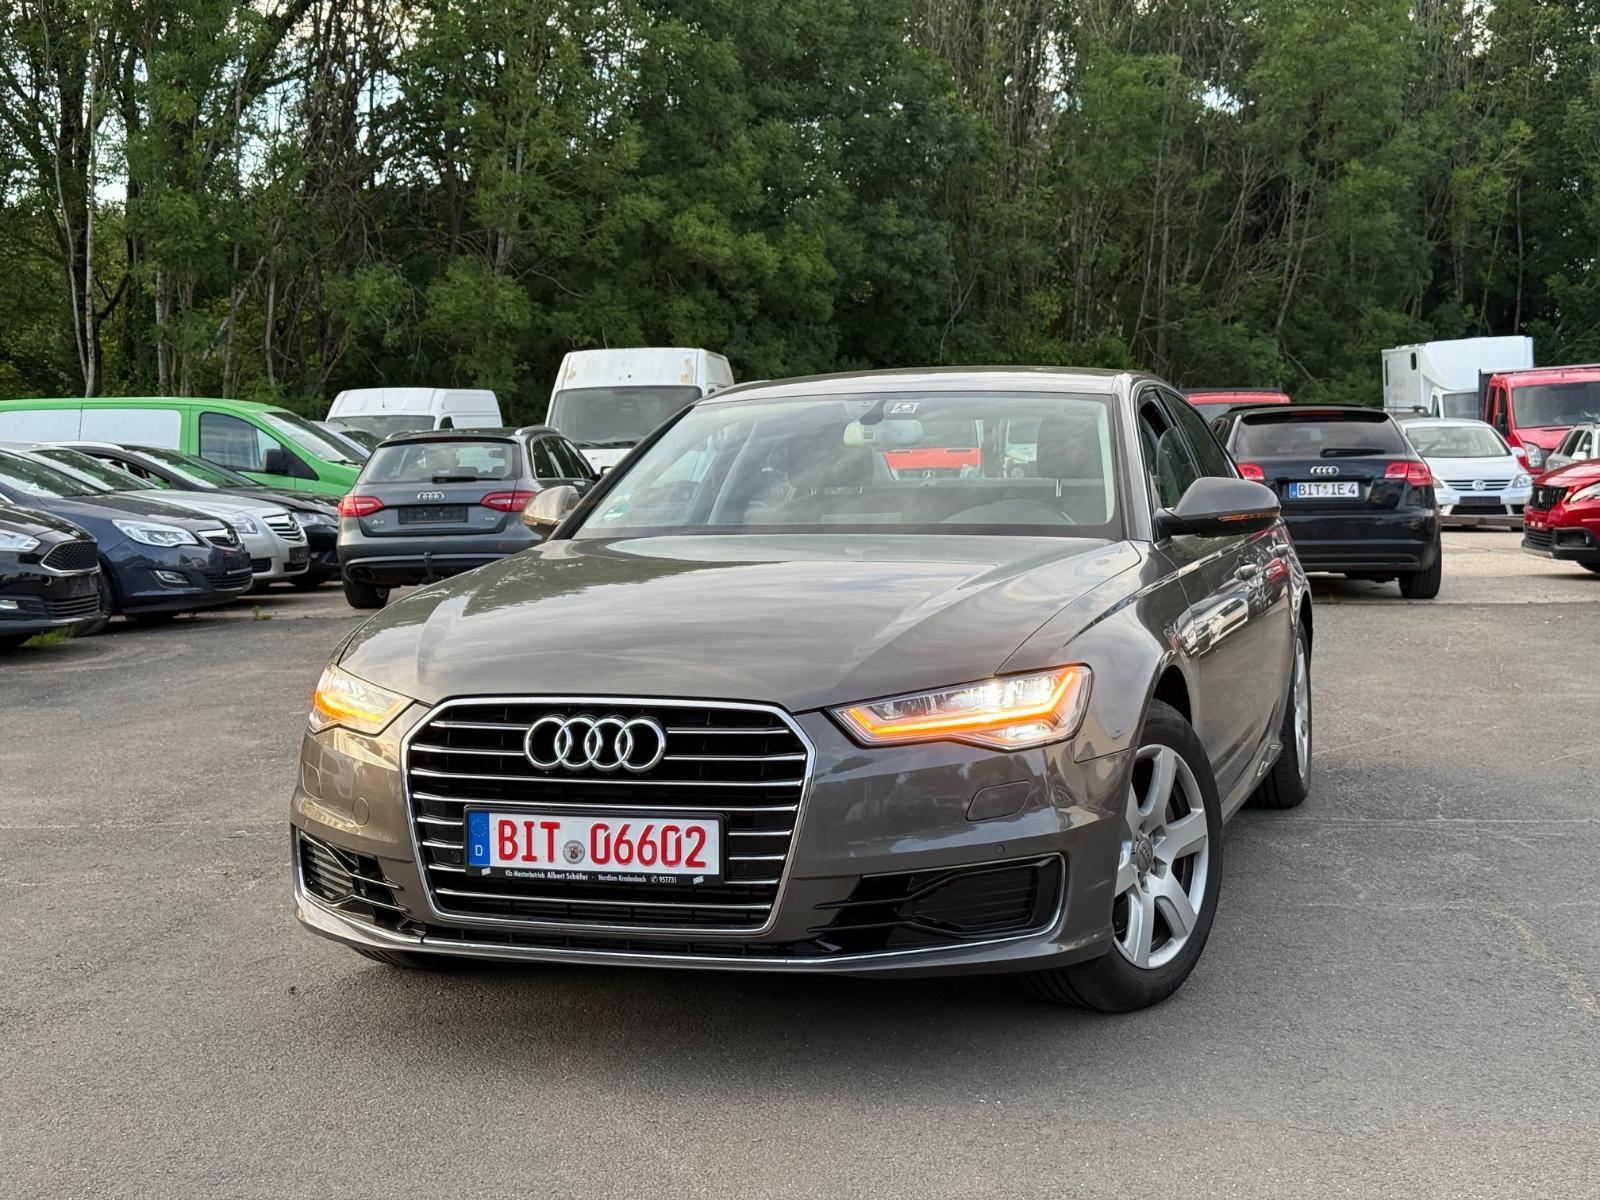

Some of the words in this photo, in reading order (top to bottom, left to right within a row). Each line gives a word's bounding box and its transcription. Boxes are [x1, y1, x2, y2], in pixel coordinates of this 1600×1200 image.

[1298, 484, 1321, 495] BIT
[497, 819, 561, 863] BIT
[590, 823, 706, 868] 06602
[475, 845, 484, 857] D
[547, 871, 565, 880] Albert
